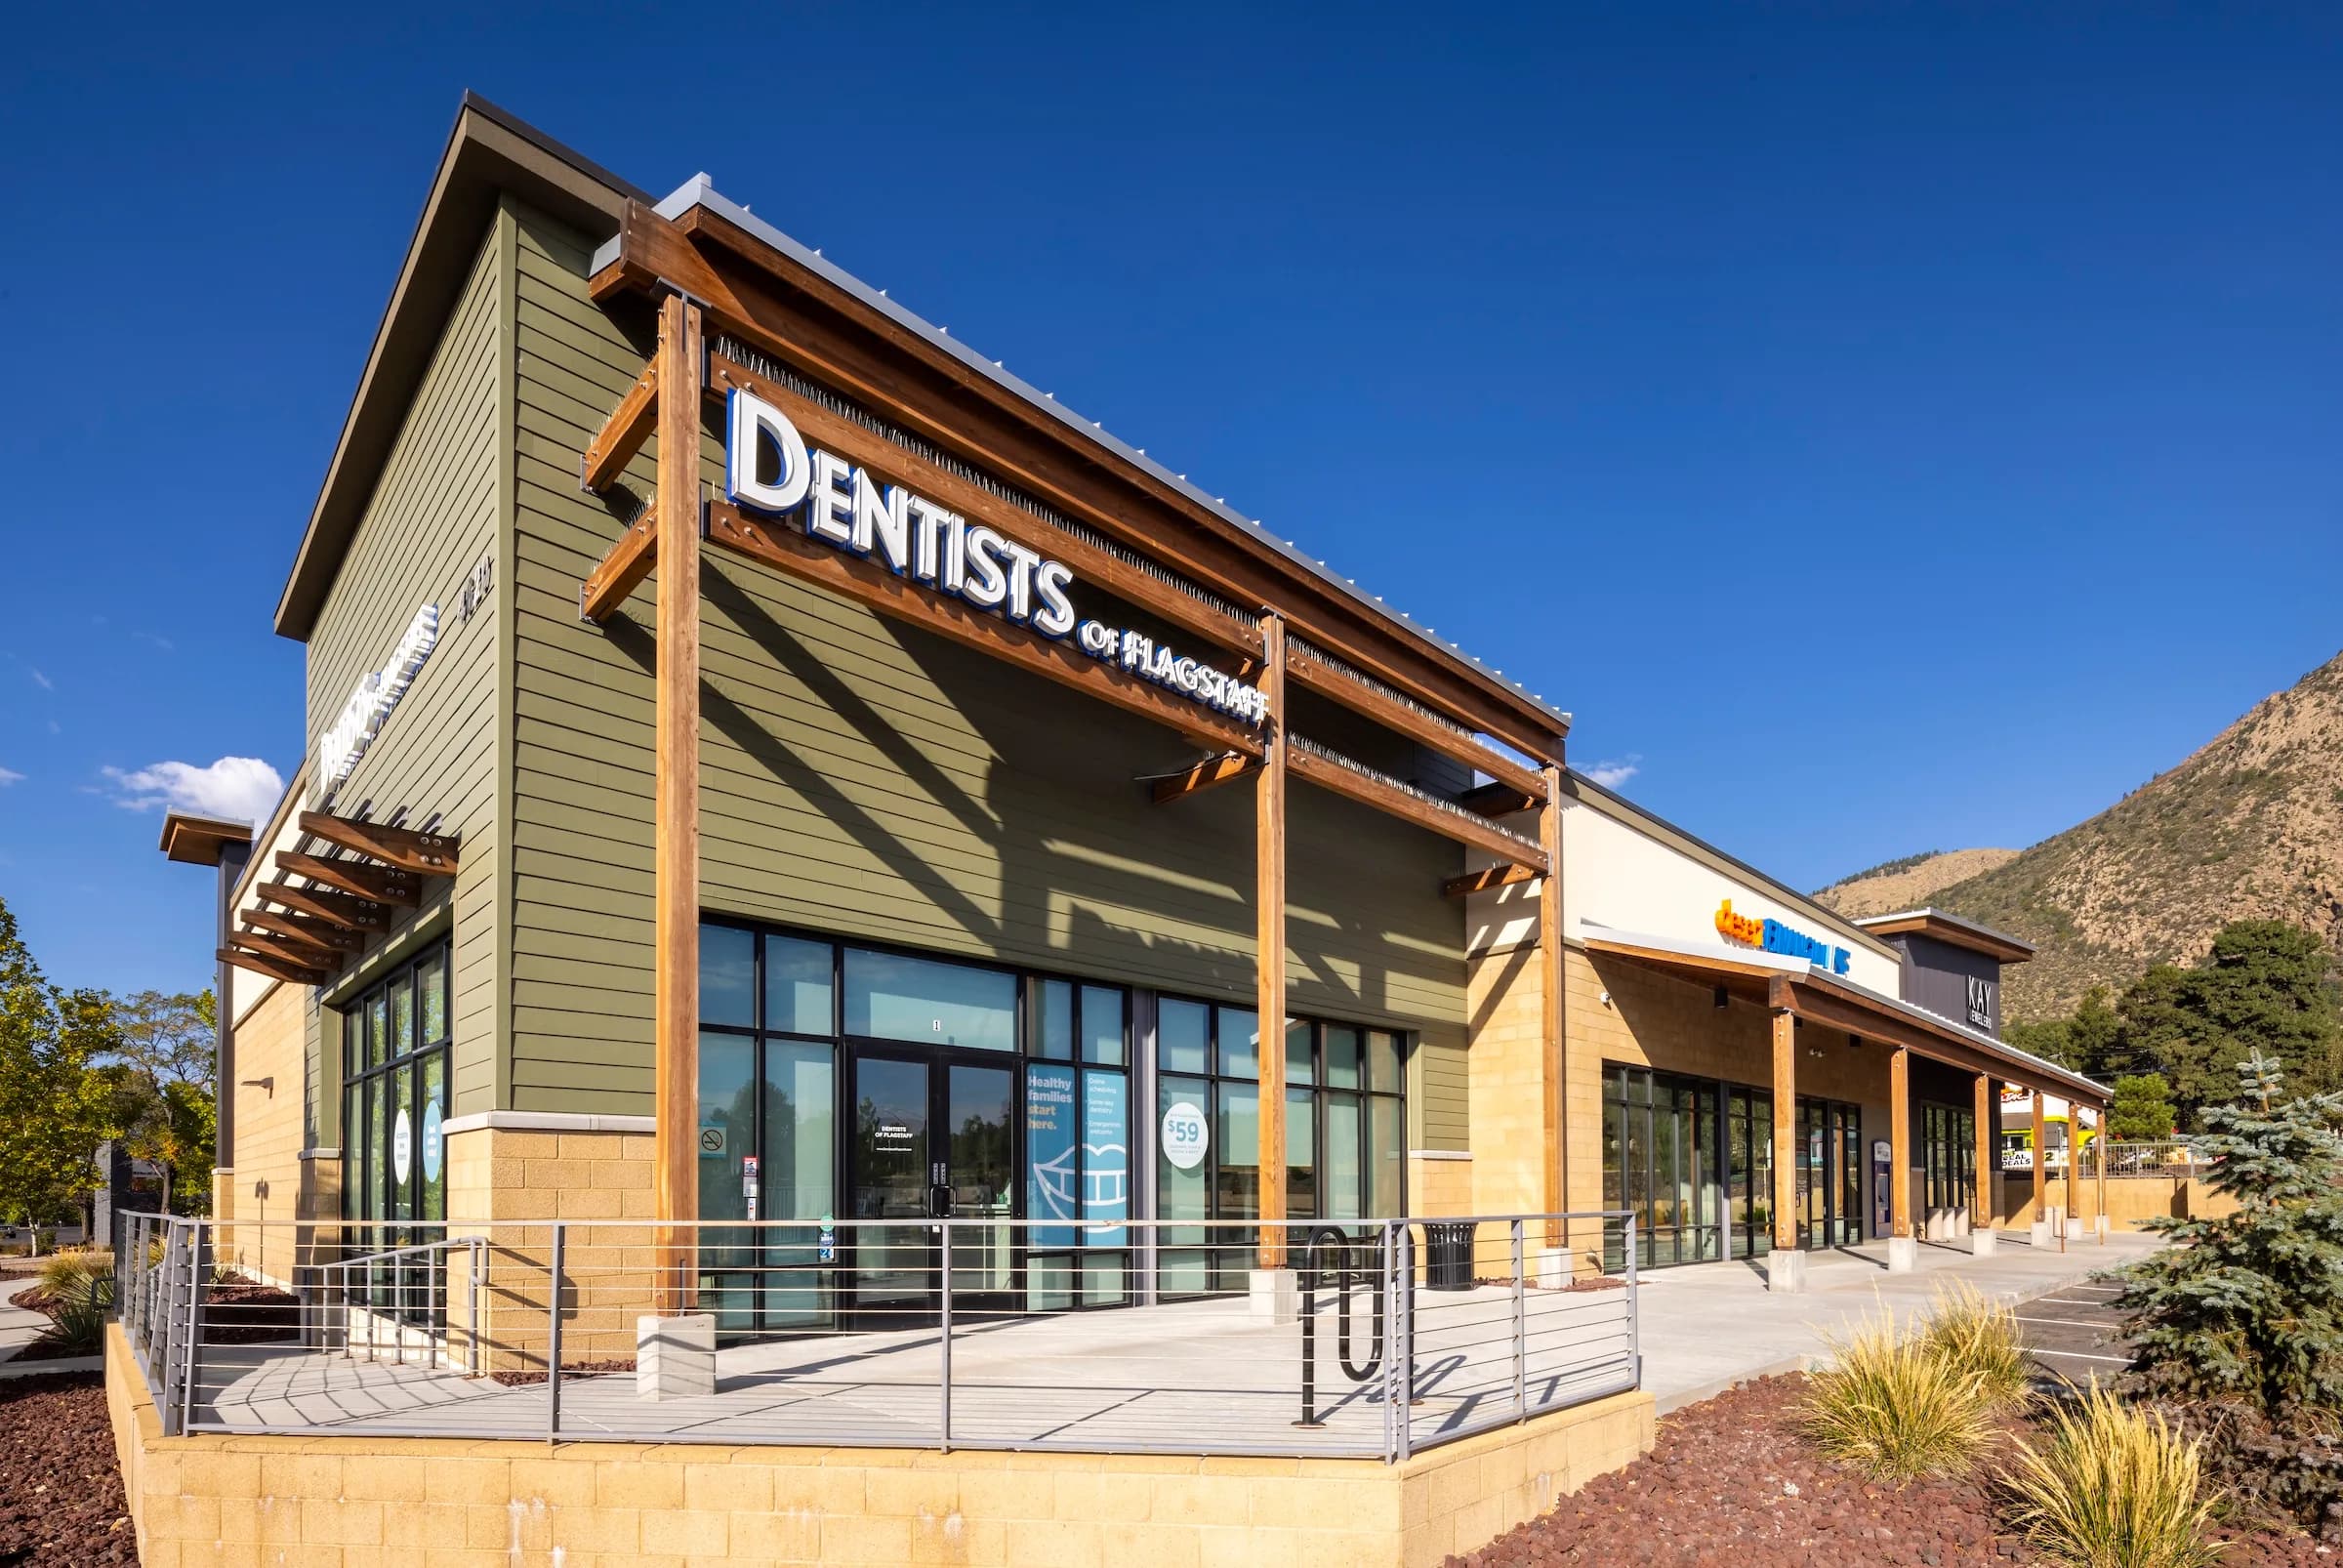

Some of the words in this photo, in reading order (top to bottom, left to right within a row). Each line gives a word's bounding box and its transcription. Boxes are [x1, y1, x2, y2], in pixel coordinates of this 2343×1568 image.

[729, 388, 1075, 638] DENTISTS
[1078, 620, 1120, 662] OF
[1122, 629, 1269, 724] FLAGSTAFF
[1968, 974, 1992, 1016] KAY
[1969, 1009, 1993, 1030] JEWELERS
[1028, 1076, 1071, 1092] Healthy
[1028, 1090, 1072, 1103] families
[1028, 1104, 1056, 1116] start
[1028, 1118, 1057, 1131] here.
[1168, 1120, 1199, 1142] $59
